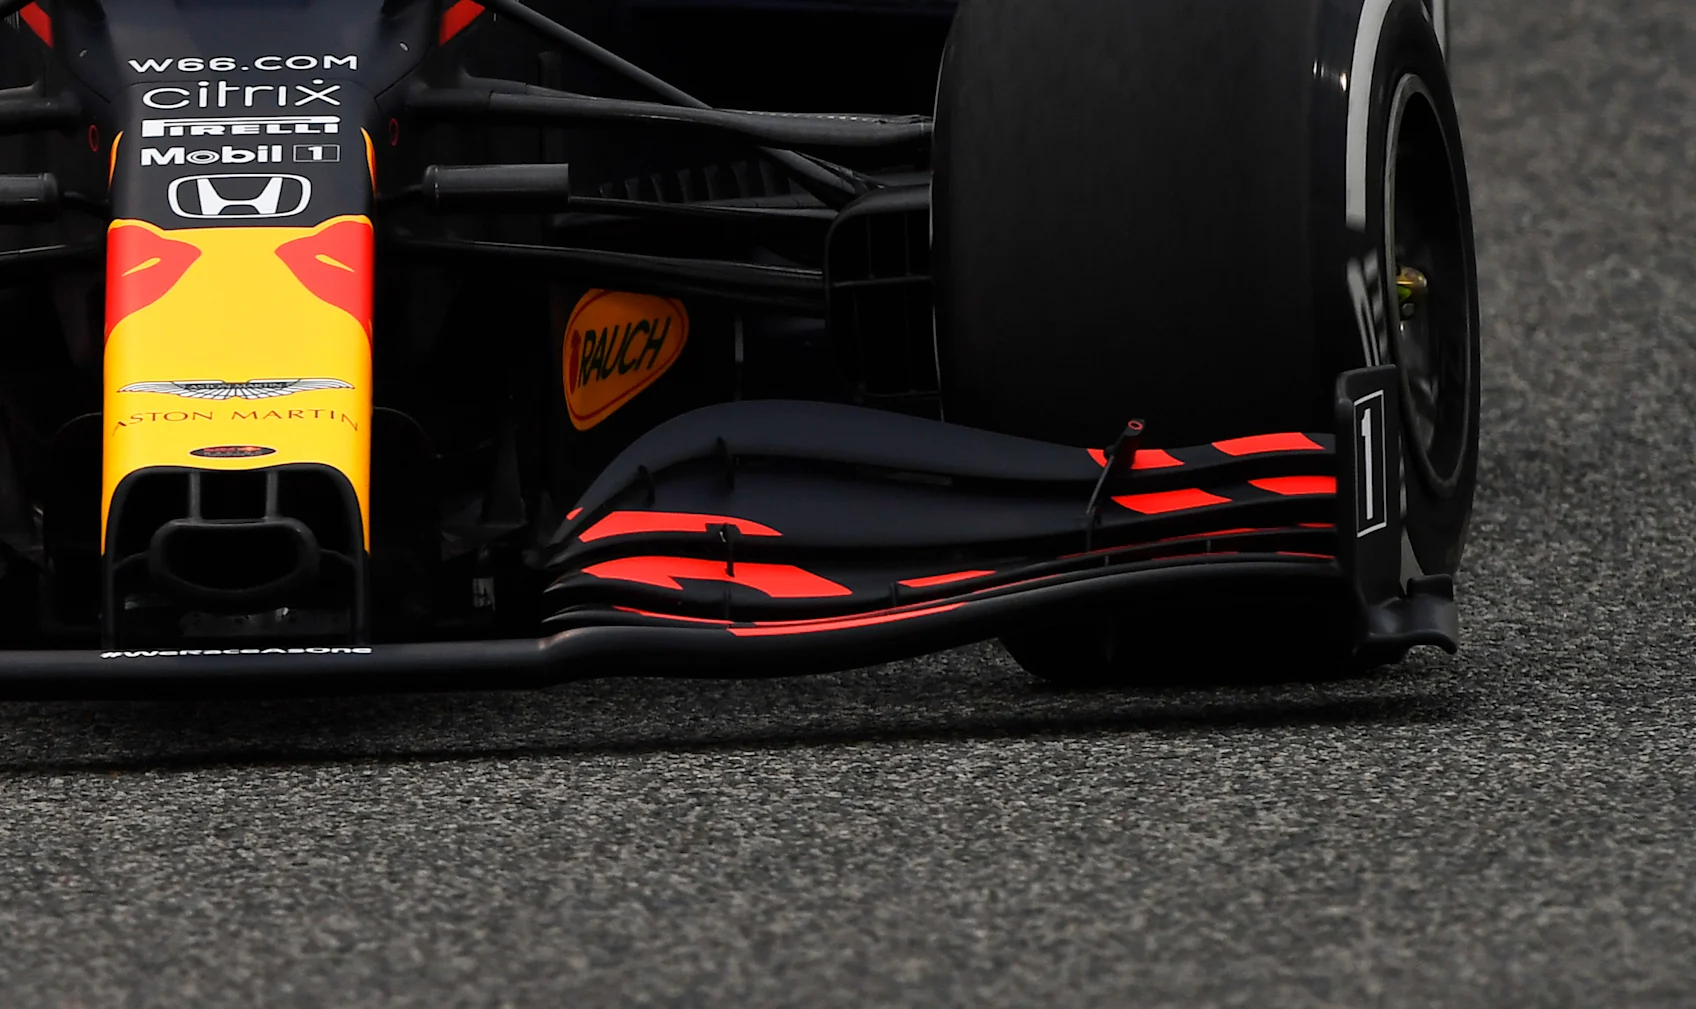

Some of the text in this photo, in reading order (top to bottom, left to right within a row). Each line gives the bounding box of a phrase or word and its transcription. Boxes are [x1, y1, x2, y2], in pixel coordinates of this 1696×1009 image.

[128, 54, 359, 73] W66.COM
[142, 78, 342, 110] citrix
[141, 115, 342, 138] PIRELLI
[140, 144, 283, 166] Mobil
[577, 316, 673, 389] RAUCH
[111, 408, 360, 437] ASTON MARTIN
